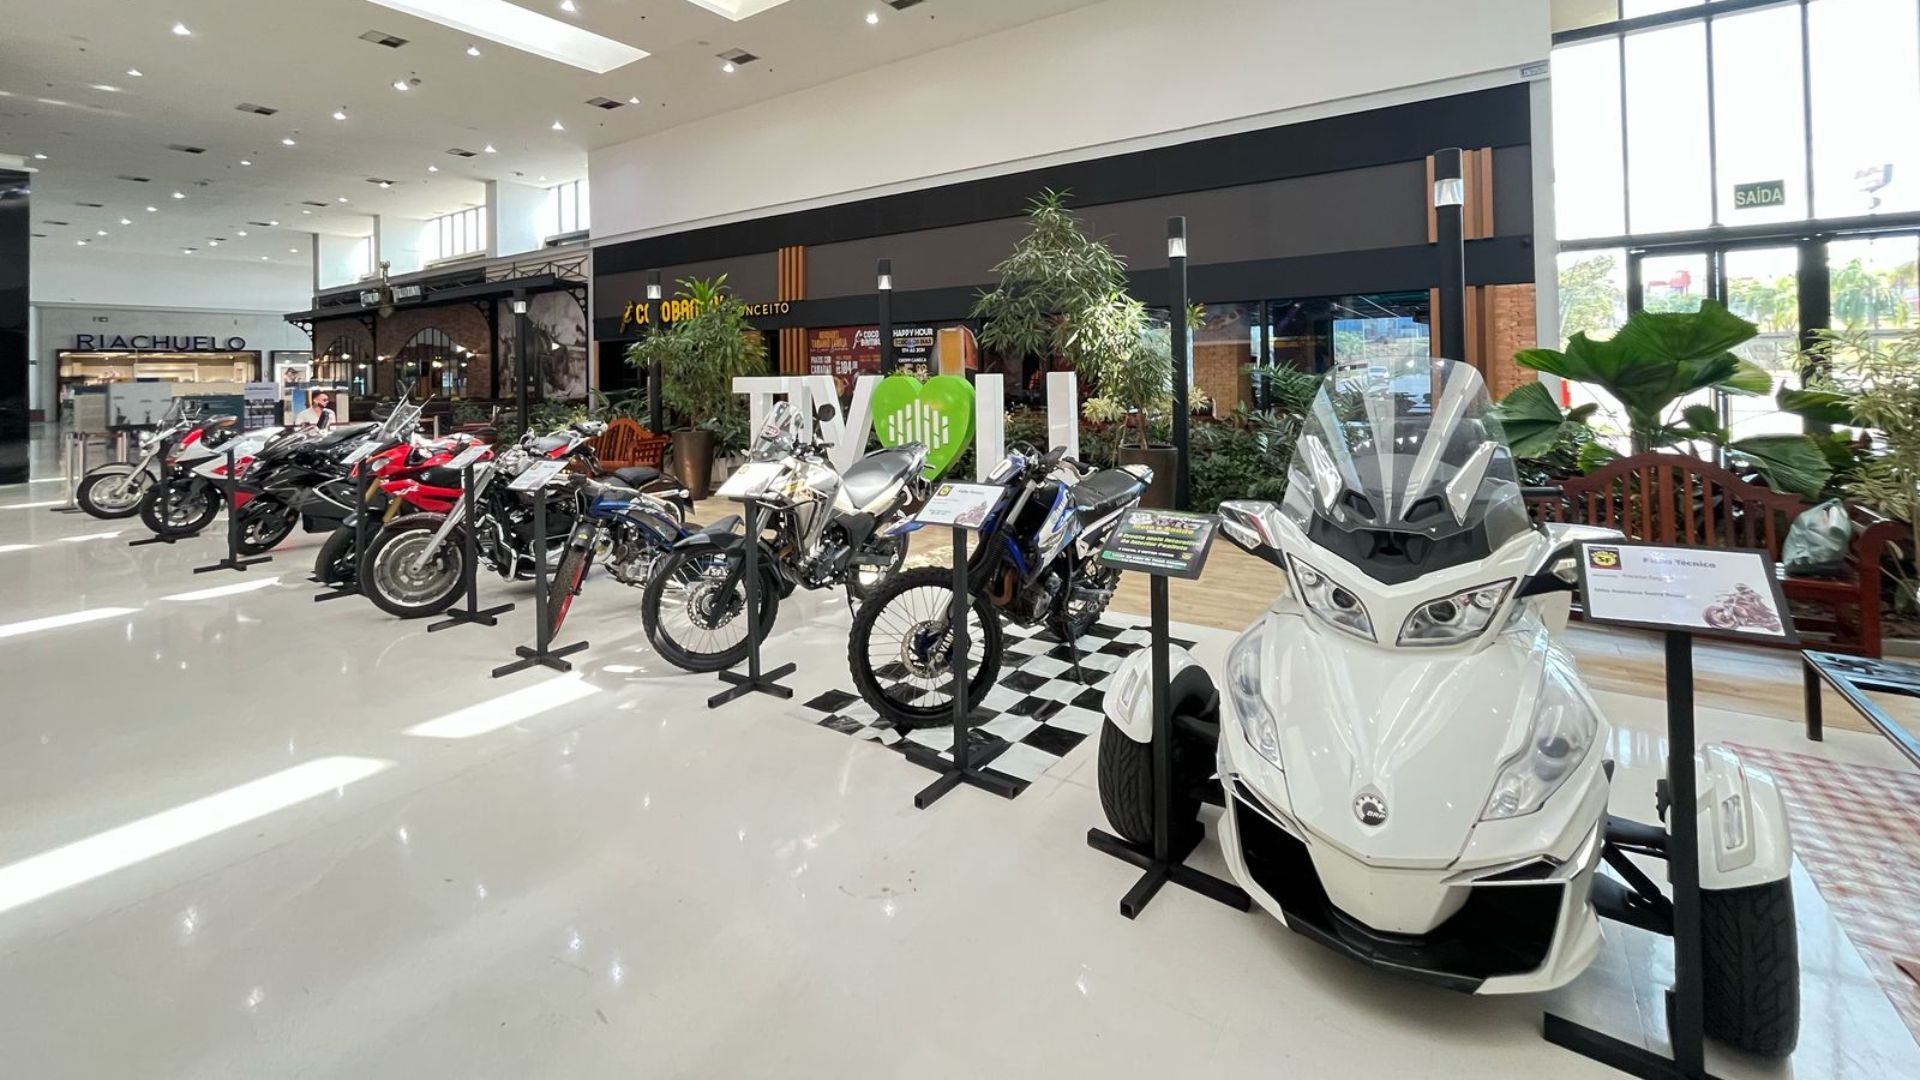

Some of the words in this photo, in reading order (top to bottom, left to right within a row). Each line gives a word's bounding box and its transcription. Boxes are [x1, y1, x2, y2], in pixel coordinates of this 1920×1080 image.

[1735, 186, 1783, 205] SAÍDA
[892, 329, 914, 337] HAPPY
[914, 328, 933, 336] HOUR
[76, 334, 247, 350] RIACHUELO
